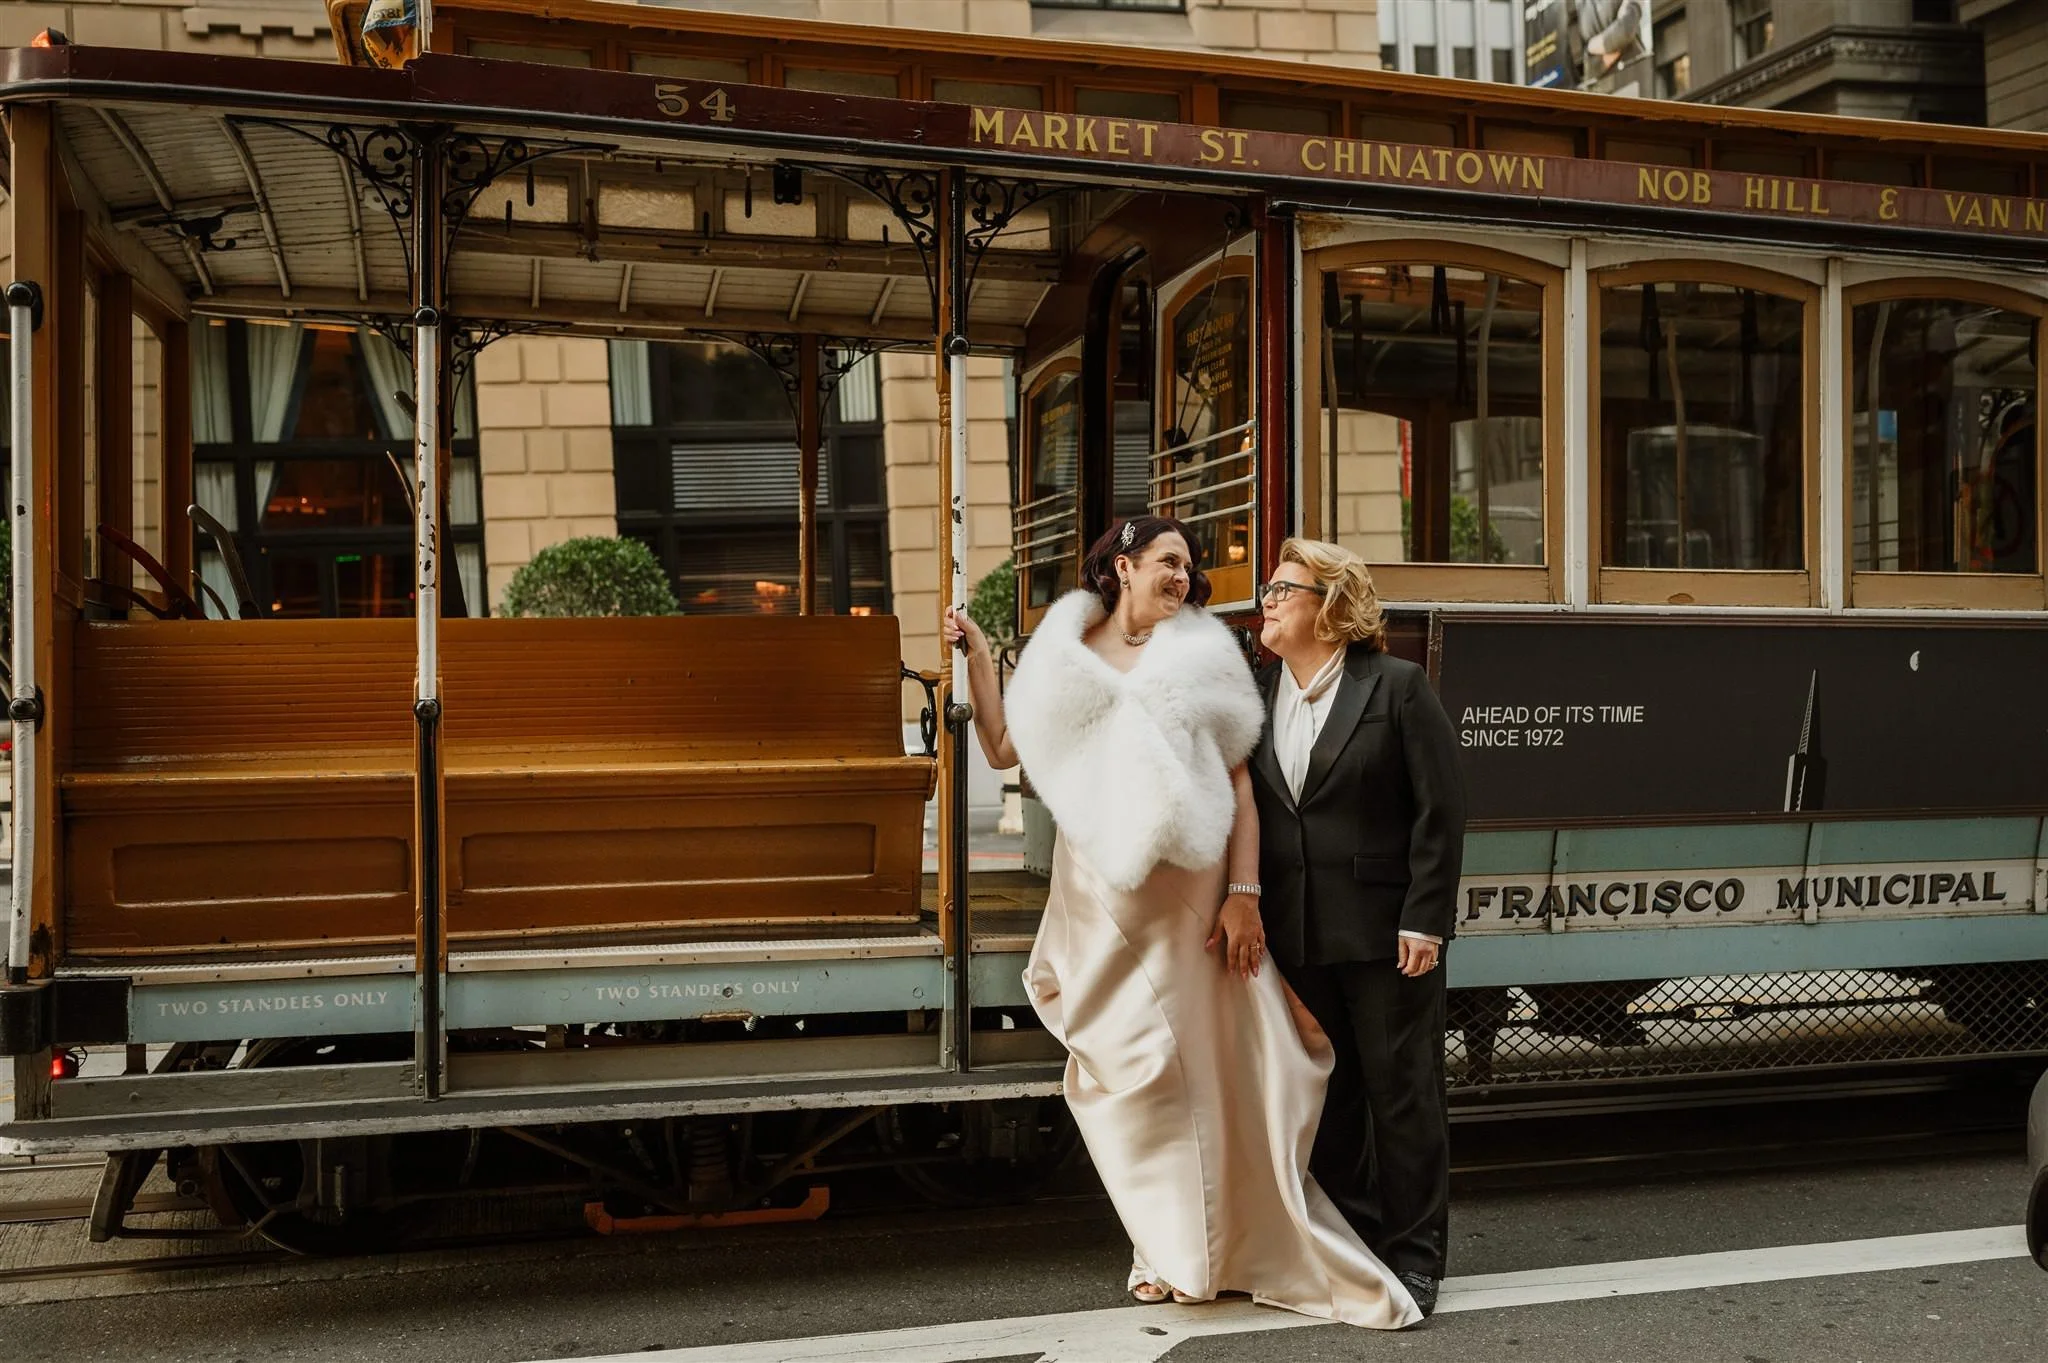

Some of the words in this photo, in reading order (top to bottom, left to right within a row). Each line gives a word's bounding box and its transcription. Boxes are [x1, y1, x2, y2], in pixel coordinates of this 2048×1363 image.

[655, 84, 736, 122] 54
[974, 108, 1158, 157] MARKET
[1200, 129, 1260, 167] ST.
[1301, 138, 1545, 190] CHINATOWN
[1638, 167, 1711, 204] NOB
[1745, 177, 1830, 214] HILL
[1879, 188, 1898, 220] &
[1944, 194, 2010, 228] VAN
[1461, 706, 1530, 724] AHEAD
[1534, 706, 1561, 724] OF
[1566, 705, 1594, 724] ITS
[1599, 705, 1645, 723] TIME
[1460, 729, 1519, 747] SINCE
[1524, 728, 1564, 746] 1972
[1465, 877, 1745, 921] FRANCISCO
[1776, 871, 2007, 909] MUNICIPAL
[596, 986, 640, 1000] TWO
[649, 982, 743, 998] STANDES
[752, 981, 800, 995] ONLY
[157, 1001, 208, 1017] TWO
[218, 995, 324, 1014] STANDEES
[333, 991, 388, 1008] ONLY
